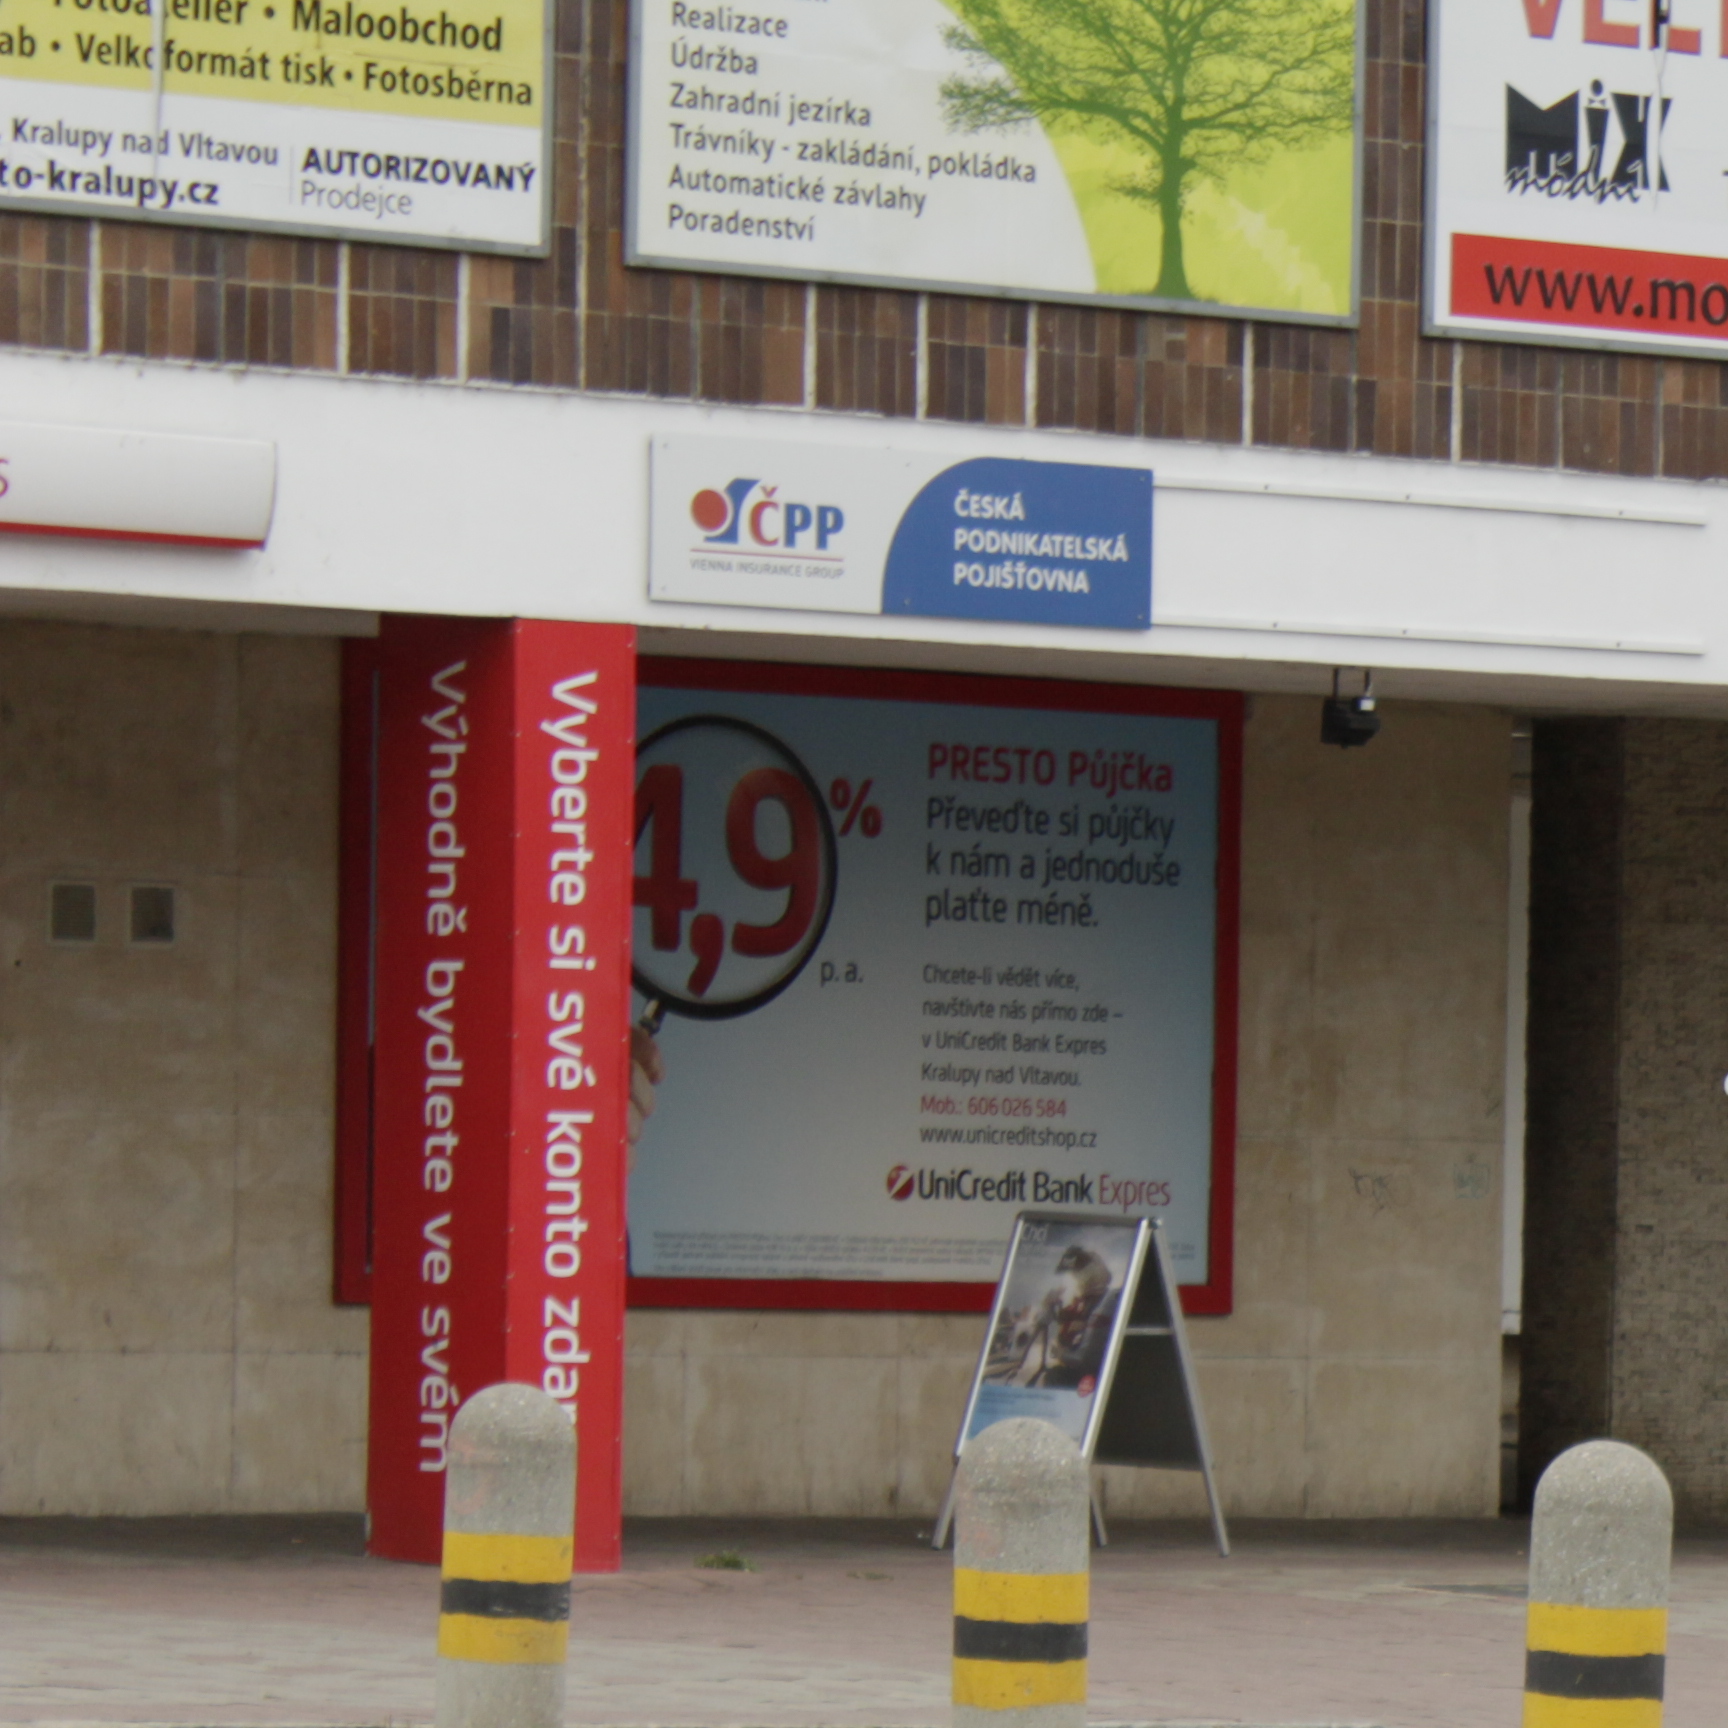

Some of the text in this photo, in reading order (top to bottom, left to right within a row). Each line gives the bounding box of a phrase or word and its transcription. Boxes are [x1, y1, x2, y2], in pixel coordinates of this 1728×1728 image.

[293, 0, 502, 51] Maloobchod
[672, 1, 788, 38] Realizace
[671, 37, 758, 75] Údržba
[281, 52, 335, 88] tisk
[363, 61, 532, 106] Fotosběrna
[670, 83, 871, 127] Zahradní jezírka
[11, 117, 279, 165] Kralupy nad Vltavou
[670, 123, 1036, 182] Trávníky zakládání, pokládka
[302, 147, 536, 192] AUTORIZOVANÝ
[301, 179, 413, 219] Prodejce
[669, 165, 926, 218] Automatické závlahy
[668, 204, 815, 241] Poradenství
[749, 486, 845, 551] ČPP
[954, 489, 1025, 522] ČESKÁ
[954, 528, 1128, 563] PODNIKATELSKÁ
[690, 557, 845, 581] VIENNA INSURANCE GROUP
[954, 561, 1089, 595] POJIŠŤOVNA
[927, 743, 1173, 795] PRESTO Půjčka
[830, 777, 882, 838] %
[926, 796, 1175, 846] Převeďte si půjčky
[926, 841, 1180, 888] k nám a jednoduše
[925, 891, 1099, 928] plaťte méně.
[539, 671, 600, 1279] Vyberte si své konto
[820, 959, 864, 986] p. a.
[922, 964, 1081, 993] Chcete-li vědět více,
[922, 997, 1109, 1028] navštivte nás přímo zde
[922, 1031, 1107, 1059] v UniCredit Bank Expres
[416, 660, 468, 1474] Výhodně bydlete ve svém
[921, 1062, 1082, 1088] Kralupy nad Vltavou.
[921, 1096, 1067, 1118] Mob.: 606 026 584
[920, 1125, 1098, 1152] www.unicreditshop.cz
[918, 1169, 1171, 1212] UniCredit Bank Expres
